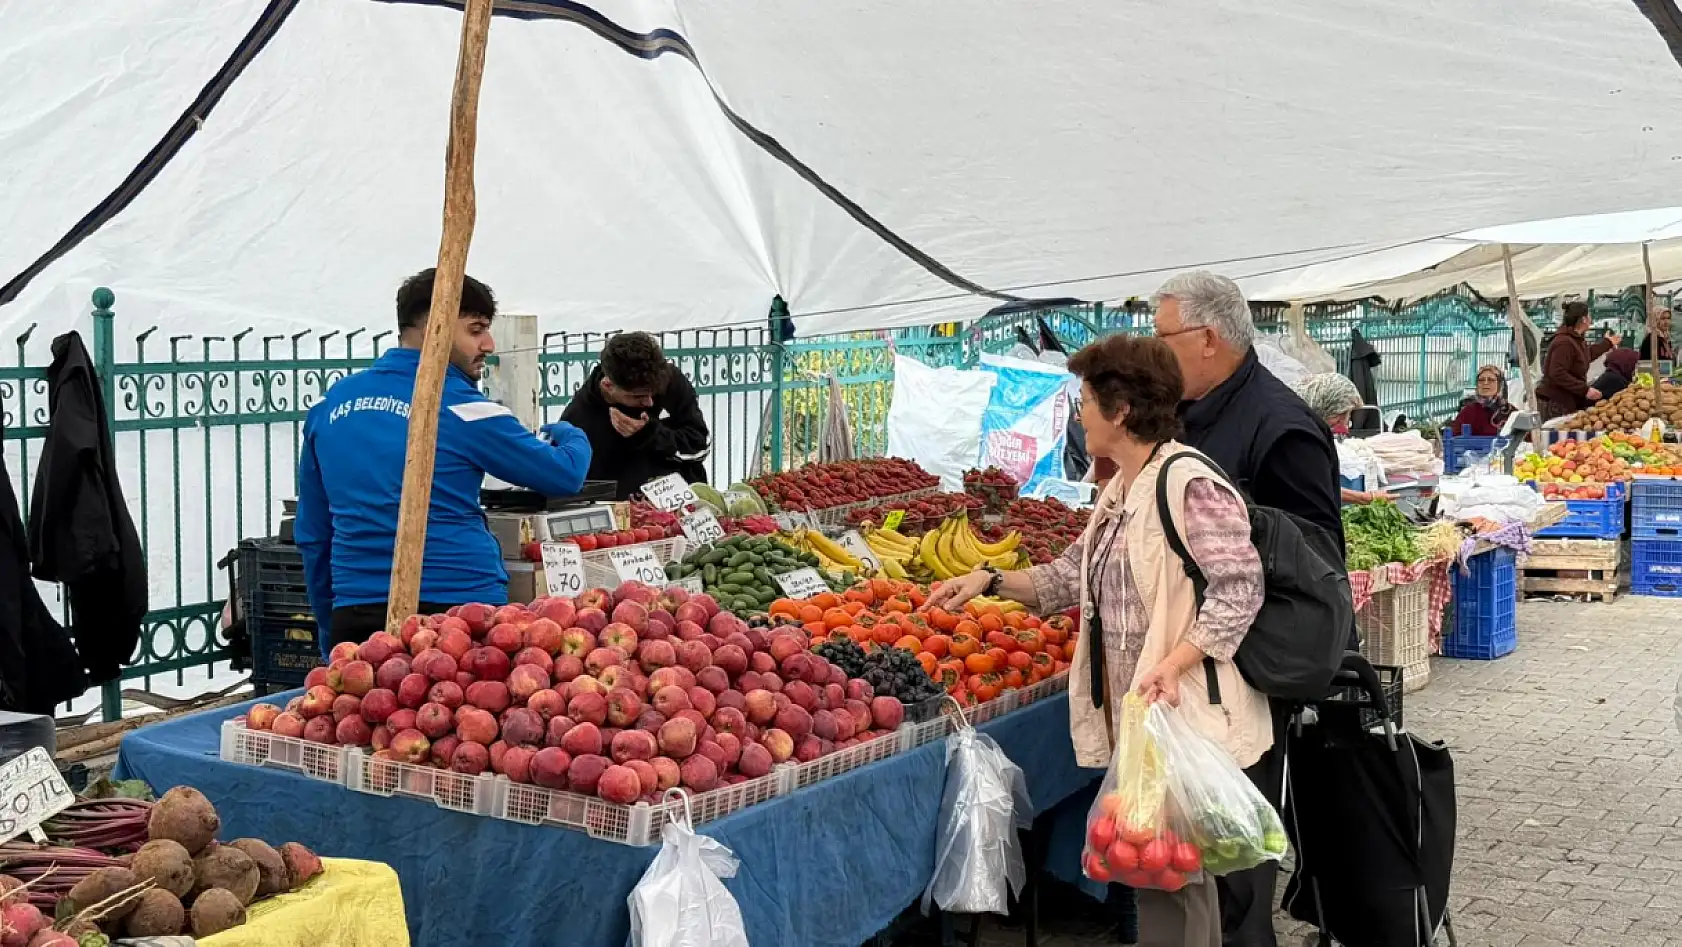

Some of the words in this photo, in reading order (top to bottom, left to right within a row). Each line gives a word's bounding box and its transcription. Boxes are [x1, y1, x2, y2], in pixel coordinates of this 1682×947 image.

[329, 400, 352, 425] KAŞ
[559, 573, 581, 592] 70
[635, 567, 664, 582] 100
